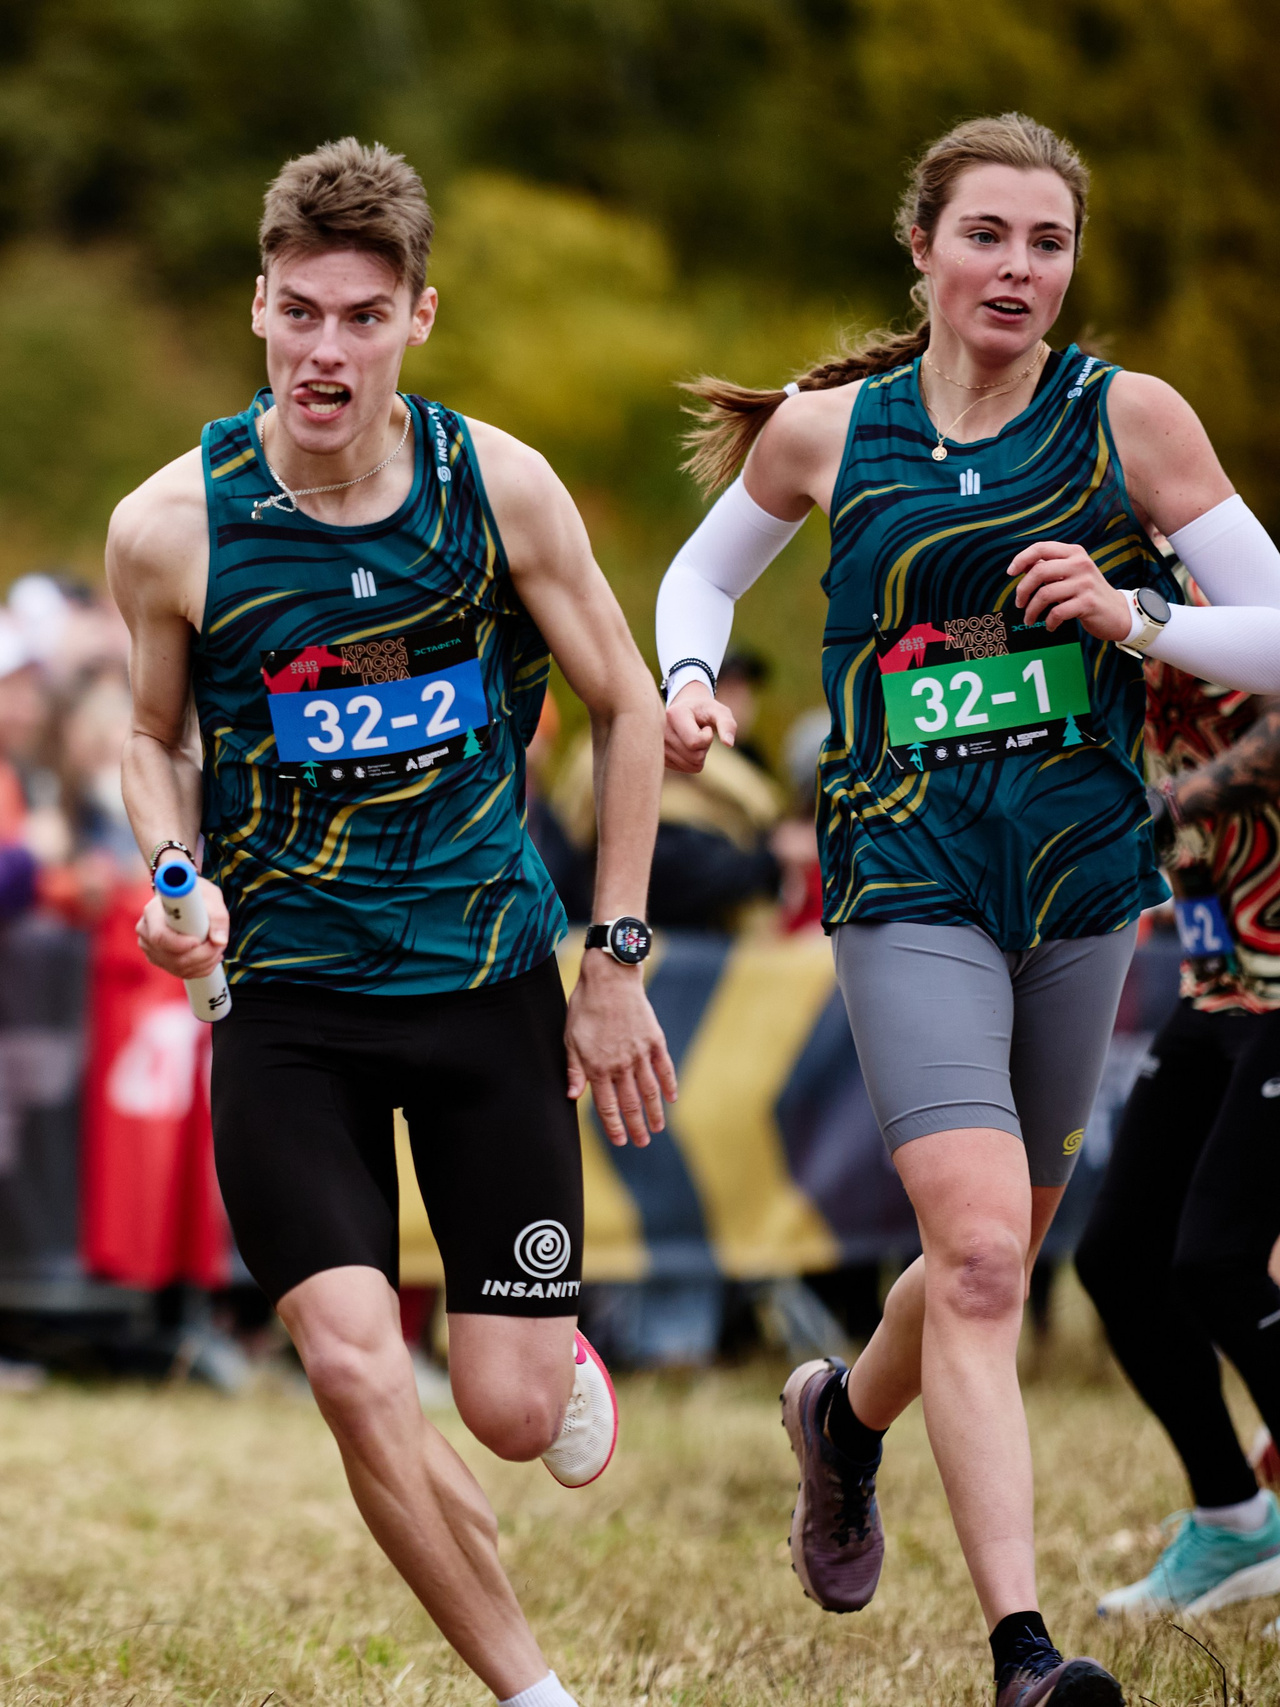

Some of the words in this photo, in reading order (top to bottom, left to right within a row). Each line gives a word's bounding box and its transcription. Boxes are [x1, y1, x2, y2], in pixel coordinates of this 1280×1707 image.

[944, 612, 1005, 635] КРОСС
[341, 637, 407, 659] КРОСС
[414, 638, 462, 656] ЭСТАФЕТА
[944, 627, 1008, 650] ЛИСЬЯ
[963, 641, 1010, 661] ГОРА
[341, 651, 410, 676] ЛИСЬЯ
[361, 666, 412, 687] ГОРА
[910, 659, 1052, 733] 32-1
[302, 679, 461, 754] 32-2
[481, 1279, 582, 1298] INSANITY
